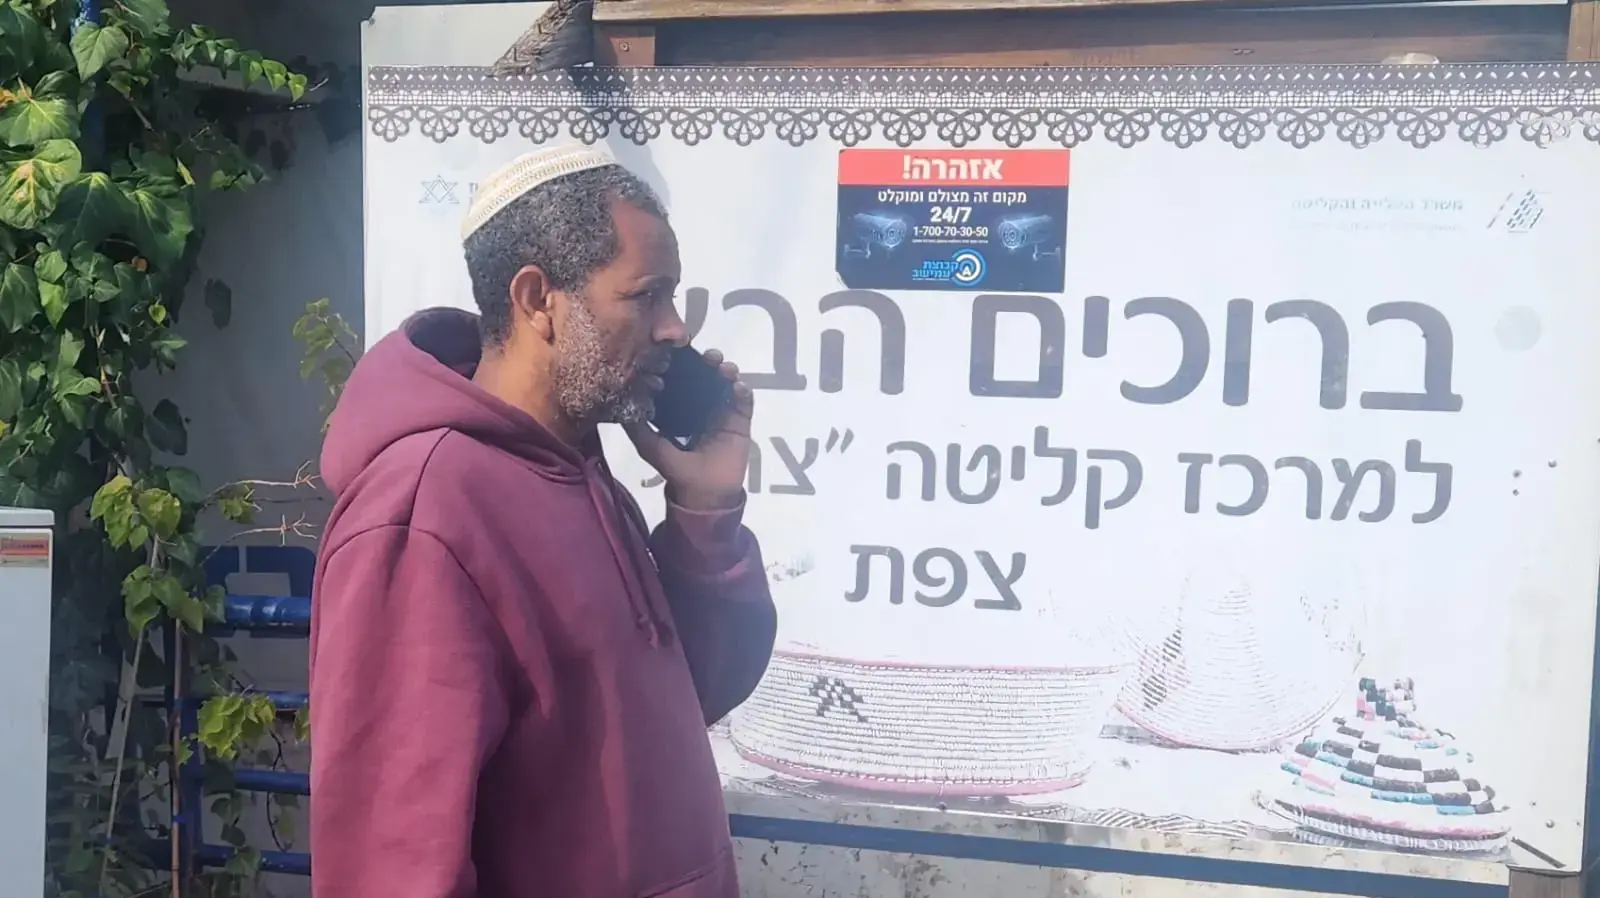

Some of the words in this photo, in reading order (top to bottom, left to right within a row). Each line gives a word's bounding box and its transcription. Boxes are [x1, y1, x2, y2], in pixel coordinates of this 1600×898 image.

[902, 154, 1004, 180] אזהרה!
[878, 188, 924, 205] ומוקלט
[928, 188, 970, 203] מצולם
[973, 191, 989, 203] זה
[992, 191, 1027, 206] מקום
[930, 206, 973, 223] 24/7
[913, 226, 989, 237] 1-700-70-30-50
[923, 260, 960, 272] קבוצת
[969, 293, 1464, 413] ברוכים
[886, 425, 1144, 530] קליטה
[1177, 438, 1453, 525] למרכז
[844, 543, 1027, 612] צפת
